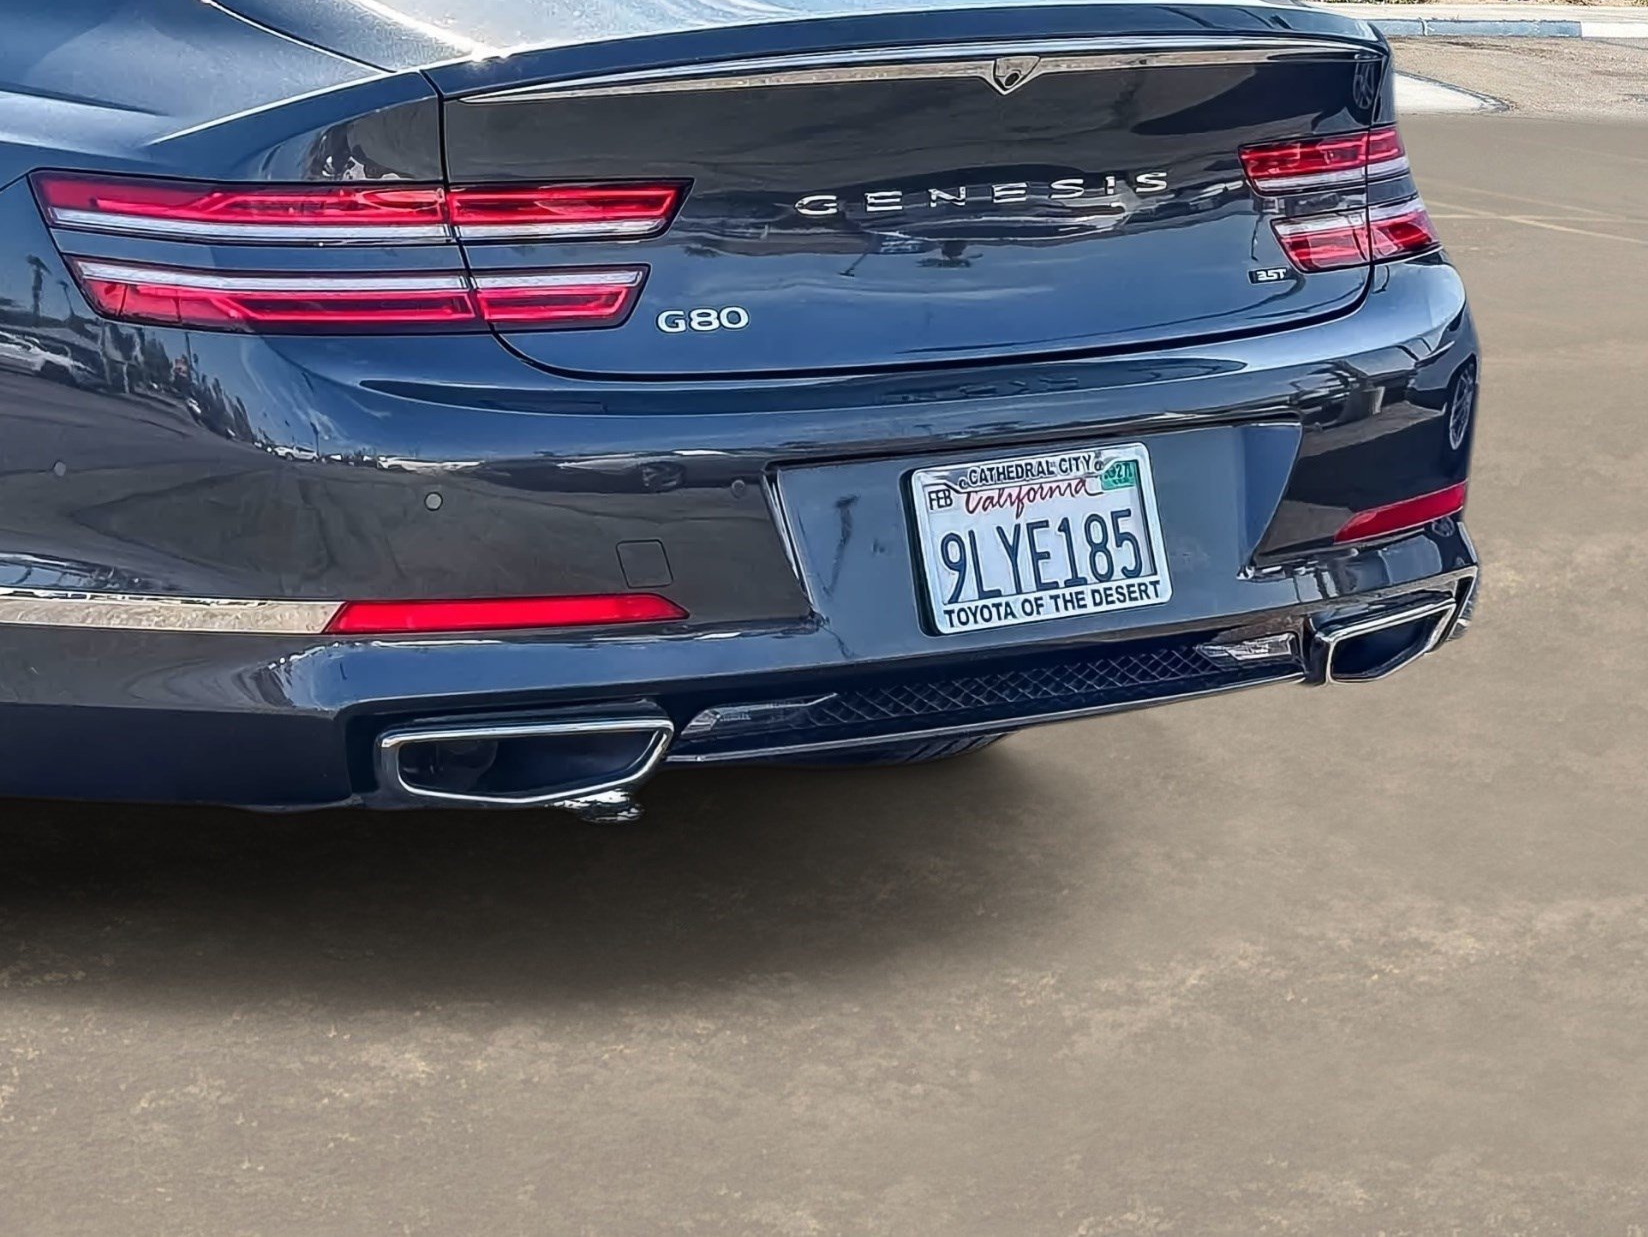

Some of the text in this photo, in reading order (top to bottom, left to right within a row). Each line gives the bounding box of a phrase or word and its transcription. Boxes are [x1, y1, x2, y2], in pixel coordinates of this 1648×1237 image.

[793, 170, 1169, 217] GENESIS
[655, 305, 751, 335] G80
[968, 454, 1093, 486] CATHEDRAL CITY
[928, 488, 954, 511] FEB
[964, 477, 1104, 519] California
[940, 508, 1144, 605] 9LYE185
[943, 580, 1161, 629] TOYOTA OF THE DESERT
